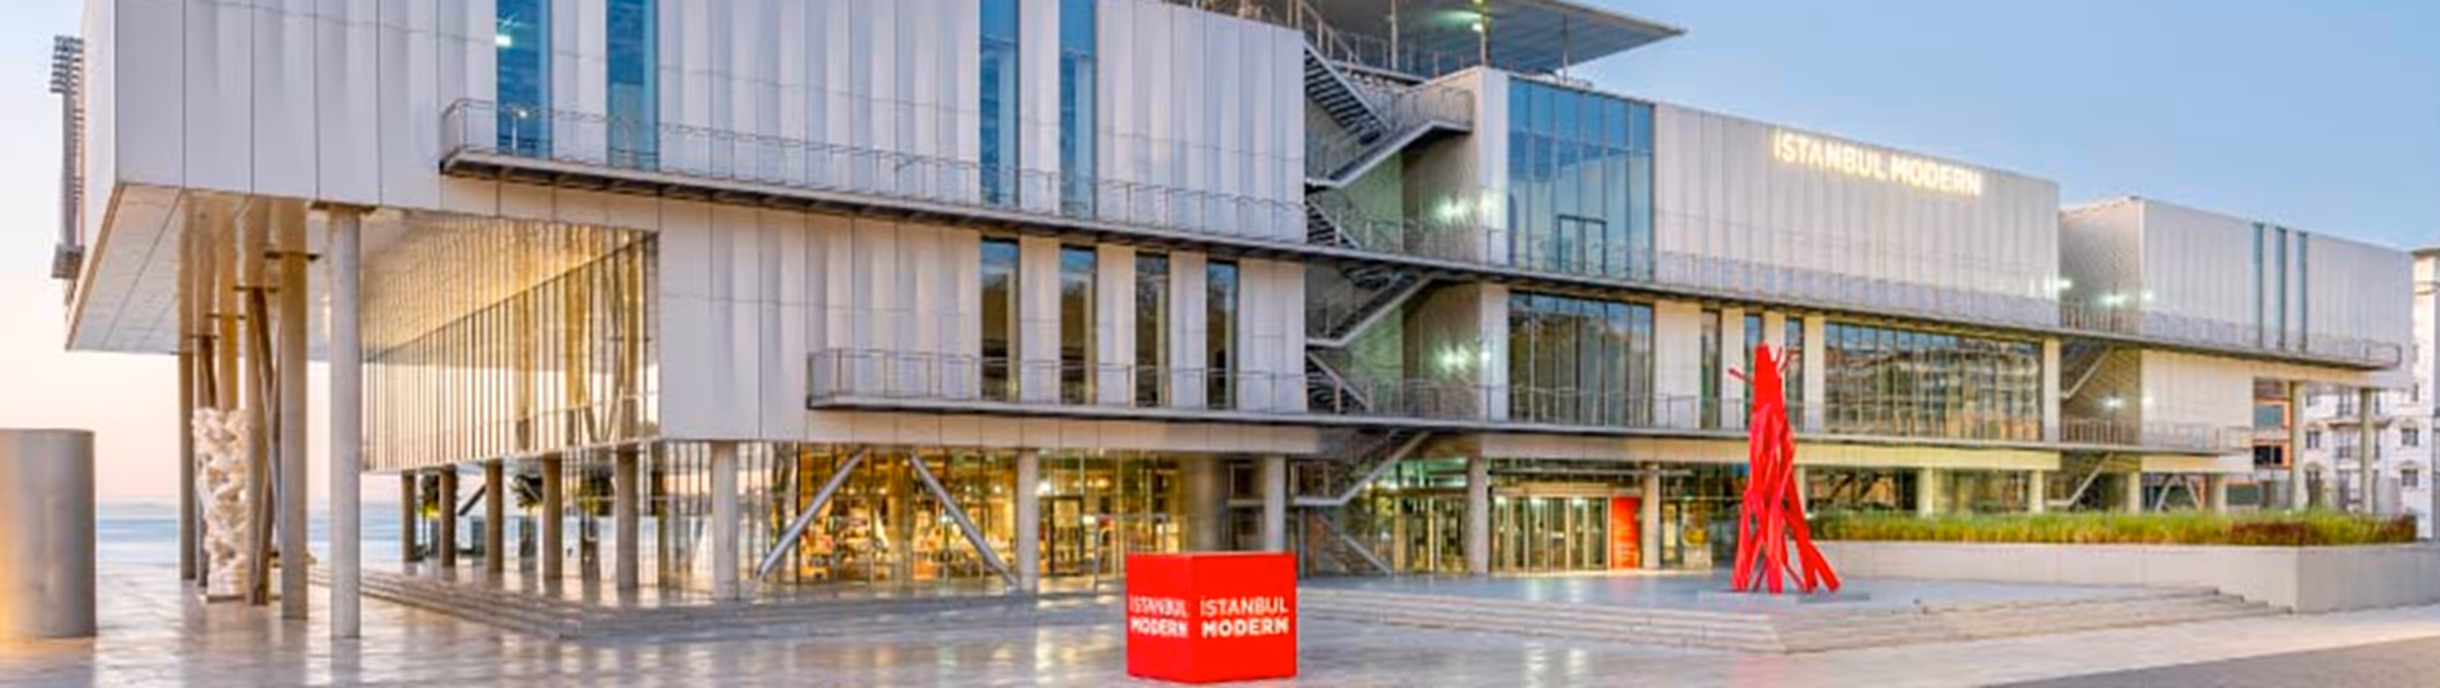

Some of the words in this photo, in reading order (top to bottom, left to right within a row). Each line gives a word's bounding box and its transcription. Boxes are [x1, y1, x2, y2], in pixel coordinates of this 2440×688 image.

[1890, 154, 1982, 197] MODERN
[1200, 595, 1289, 617] İSTANBUL
[1131, 617, 1188, 638] MODERN
[1201, 616, 1289, 638] MODERN
